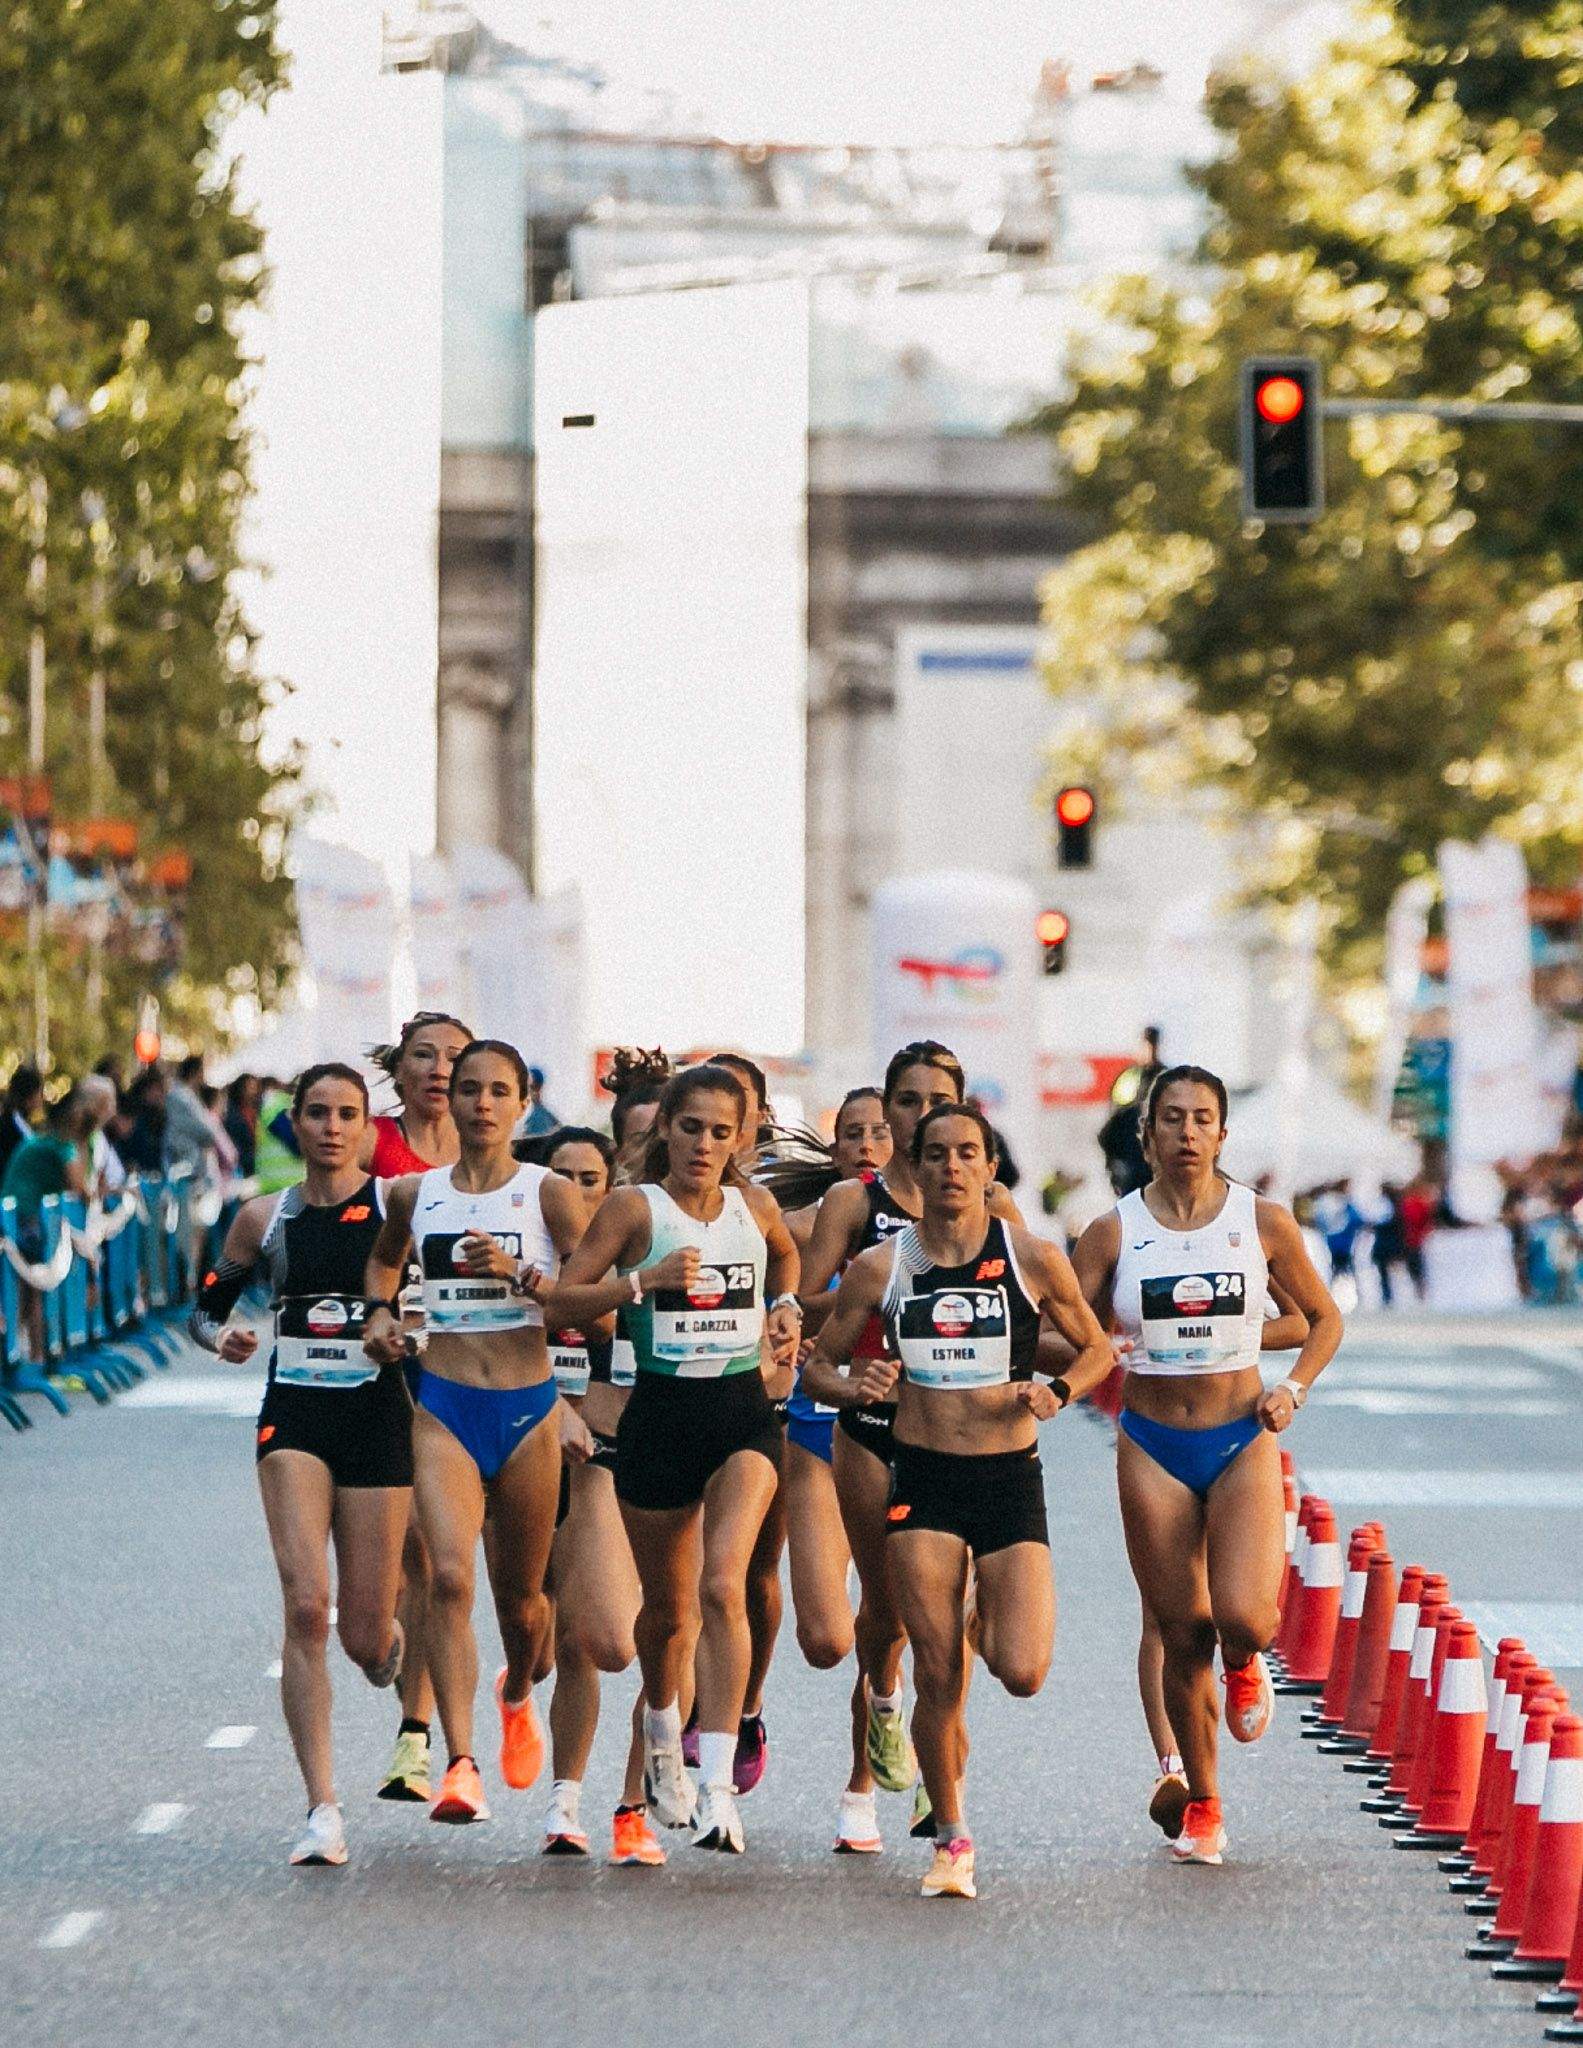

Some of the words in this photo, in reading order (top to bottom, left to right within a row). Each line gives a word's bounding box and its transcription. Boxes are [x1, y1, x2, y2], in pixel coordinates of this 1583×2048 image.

[727, 1266, 753, 1290] 25
[1215, 1274, 1243, 1297] 24
[975, 1295, 1003, 1319] 34
[675, 1321, 689, 1333] M.
[693, 1319, 738, 1333] GARZZIA
[1177, 1324, 1213, 1339] MARÍA
[932, 1347, 976, 1361] ESTHER
